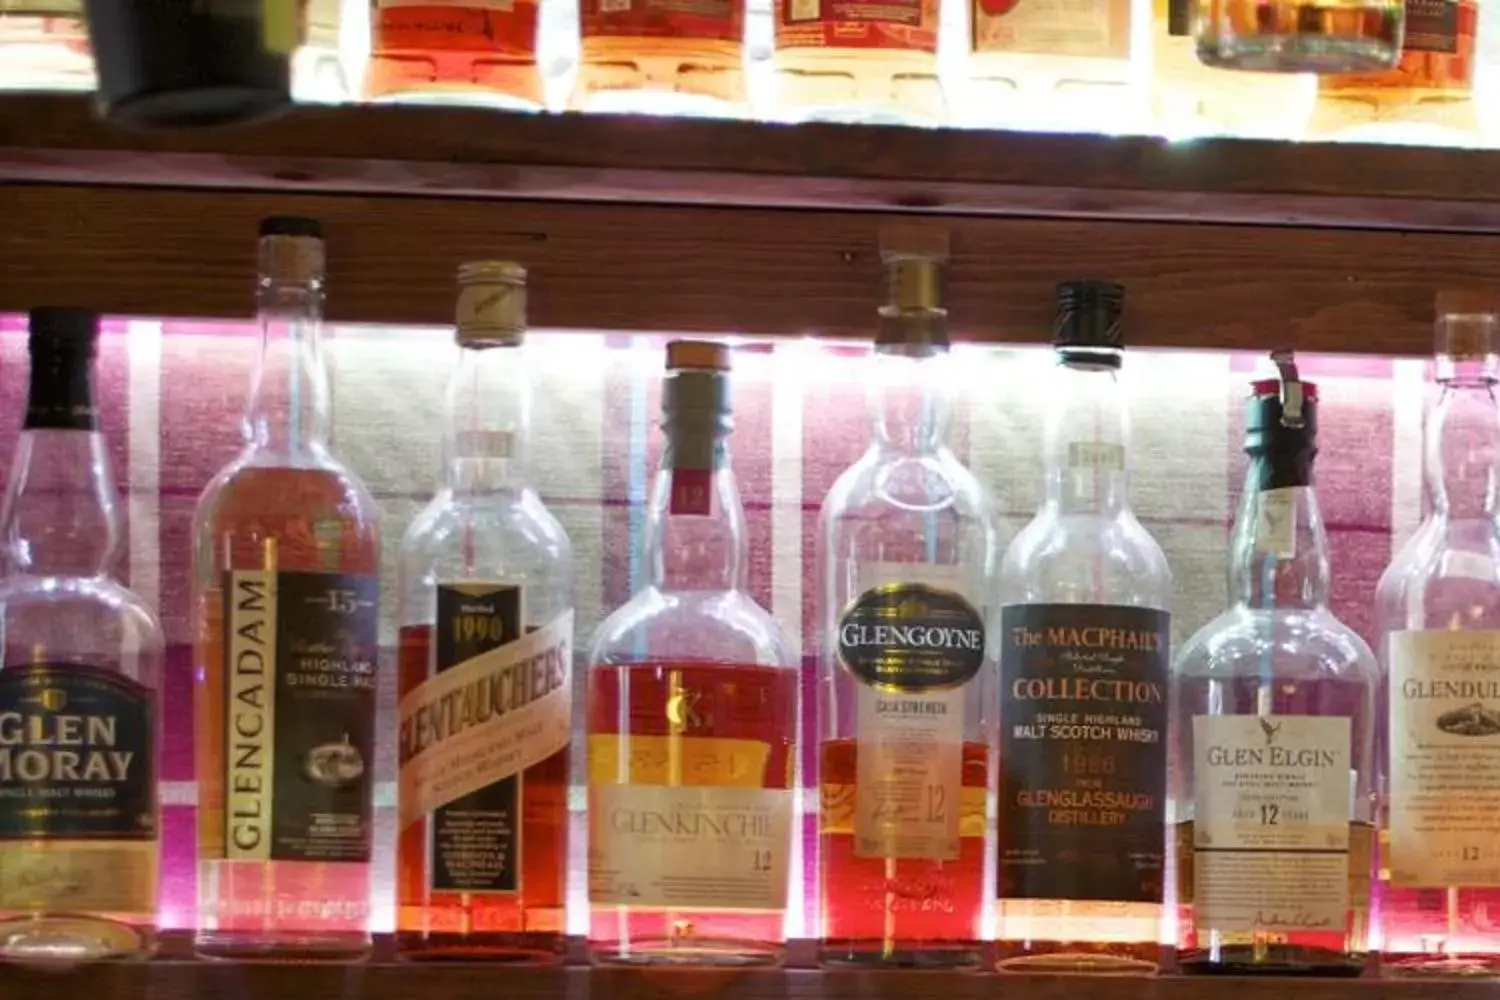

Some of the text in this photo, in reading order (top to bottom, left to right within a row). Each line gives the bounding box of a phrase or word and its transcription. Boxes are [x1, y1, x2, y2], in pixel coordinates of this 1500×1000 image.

[841, 623, 982, 651] GLENGOYNE
[1011, 628, 1043, 647] The
[1012, 677, 1163, 704] COLLECTION
[233, 577, 267, 852] GLENCADAM
[0, 711, 117, 746] GLEN
[1012, 726, 1046, 740] MALT
[1049, 726, 1113, 741] SCOTCH
[1207, 745, 1335, 769] GLEN ELGIN
[927, 784, 947, 823] 12
[1260, 803, 1279, 826] 12
[1047, 811, 1127, 826] DISTILLERY
[753, 848, 773, 872] 12
